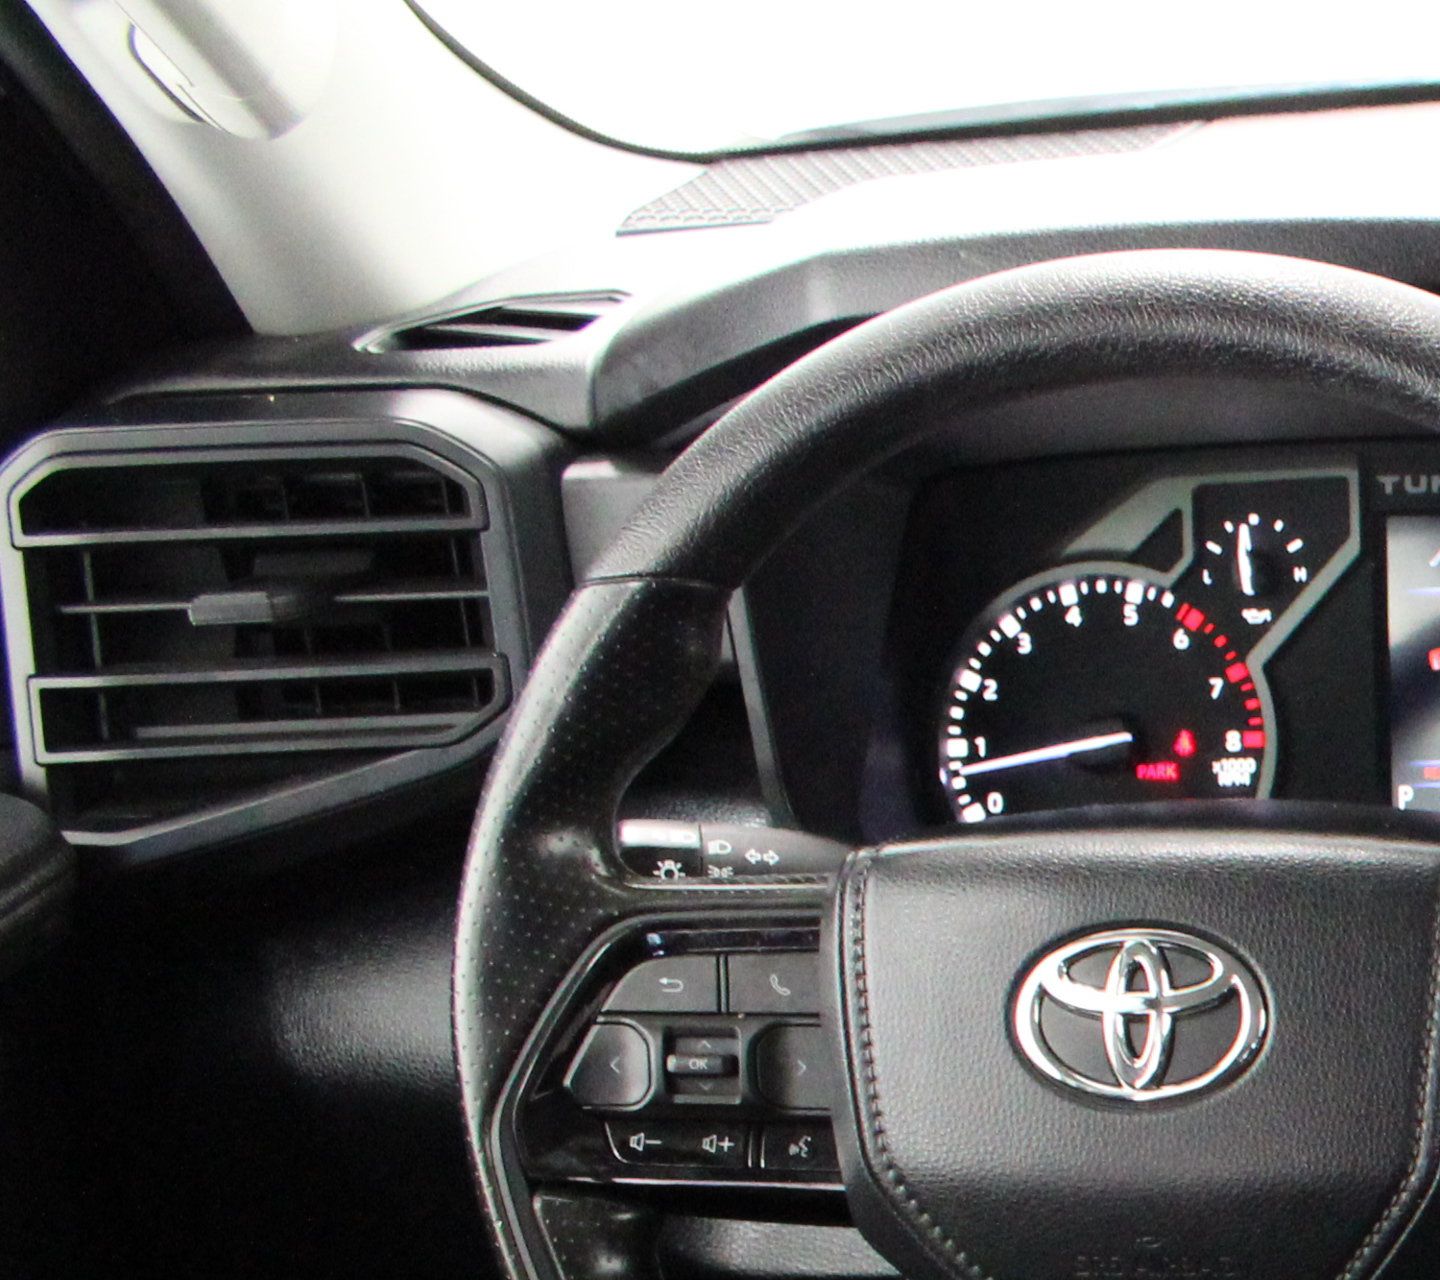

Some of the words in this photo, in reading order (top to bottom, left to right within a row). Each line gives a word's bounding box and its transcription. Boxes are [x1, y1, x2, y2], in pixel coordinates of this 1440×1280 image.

[1202, 568, 1212, 585] L
[1293, 566, 1307, 583] H
[1063, 605, 1082, 627] 4
[1123, 604, 1140, 627] 5
[1016, 631, 1031, 655] 3
[1173, 628, 1190, 650] 6
[982, 677, 998, 701] 2
[1208, 676, 1224, 700] 7
[975, 736, 987, 759] 1
[1225, 729, 1242, 753] 8
[1137, 762, 1178, 780] PARK
[987, 791, 1004, 815] 0
[1398, 784, 1414, 810] P
[688, 1057, 708, 1070] OK
